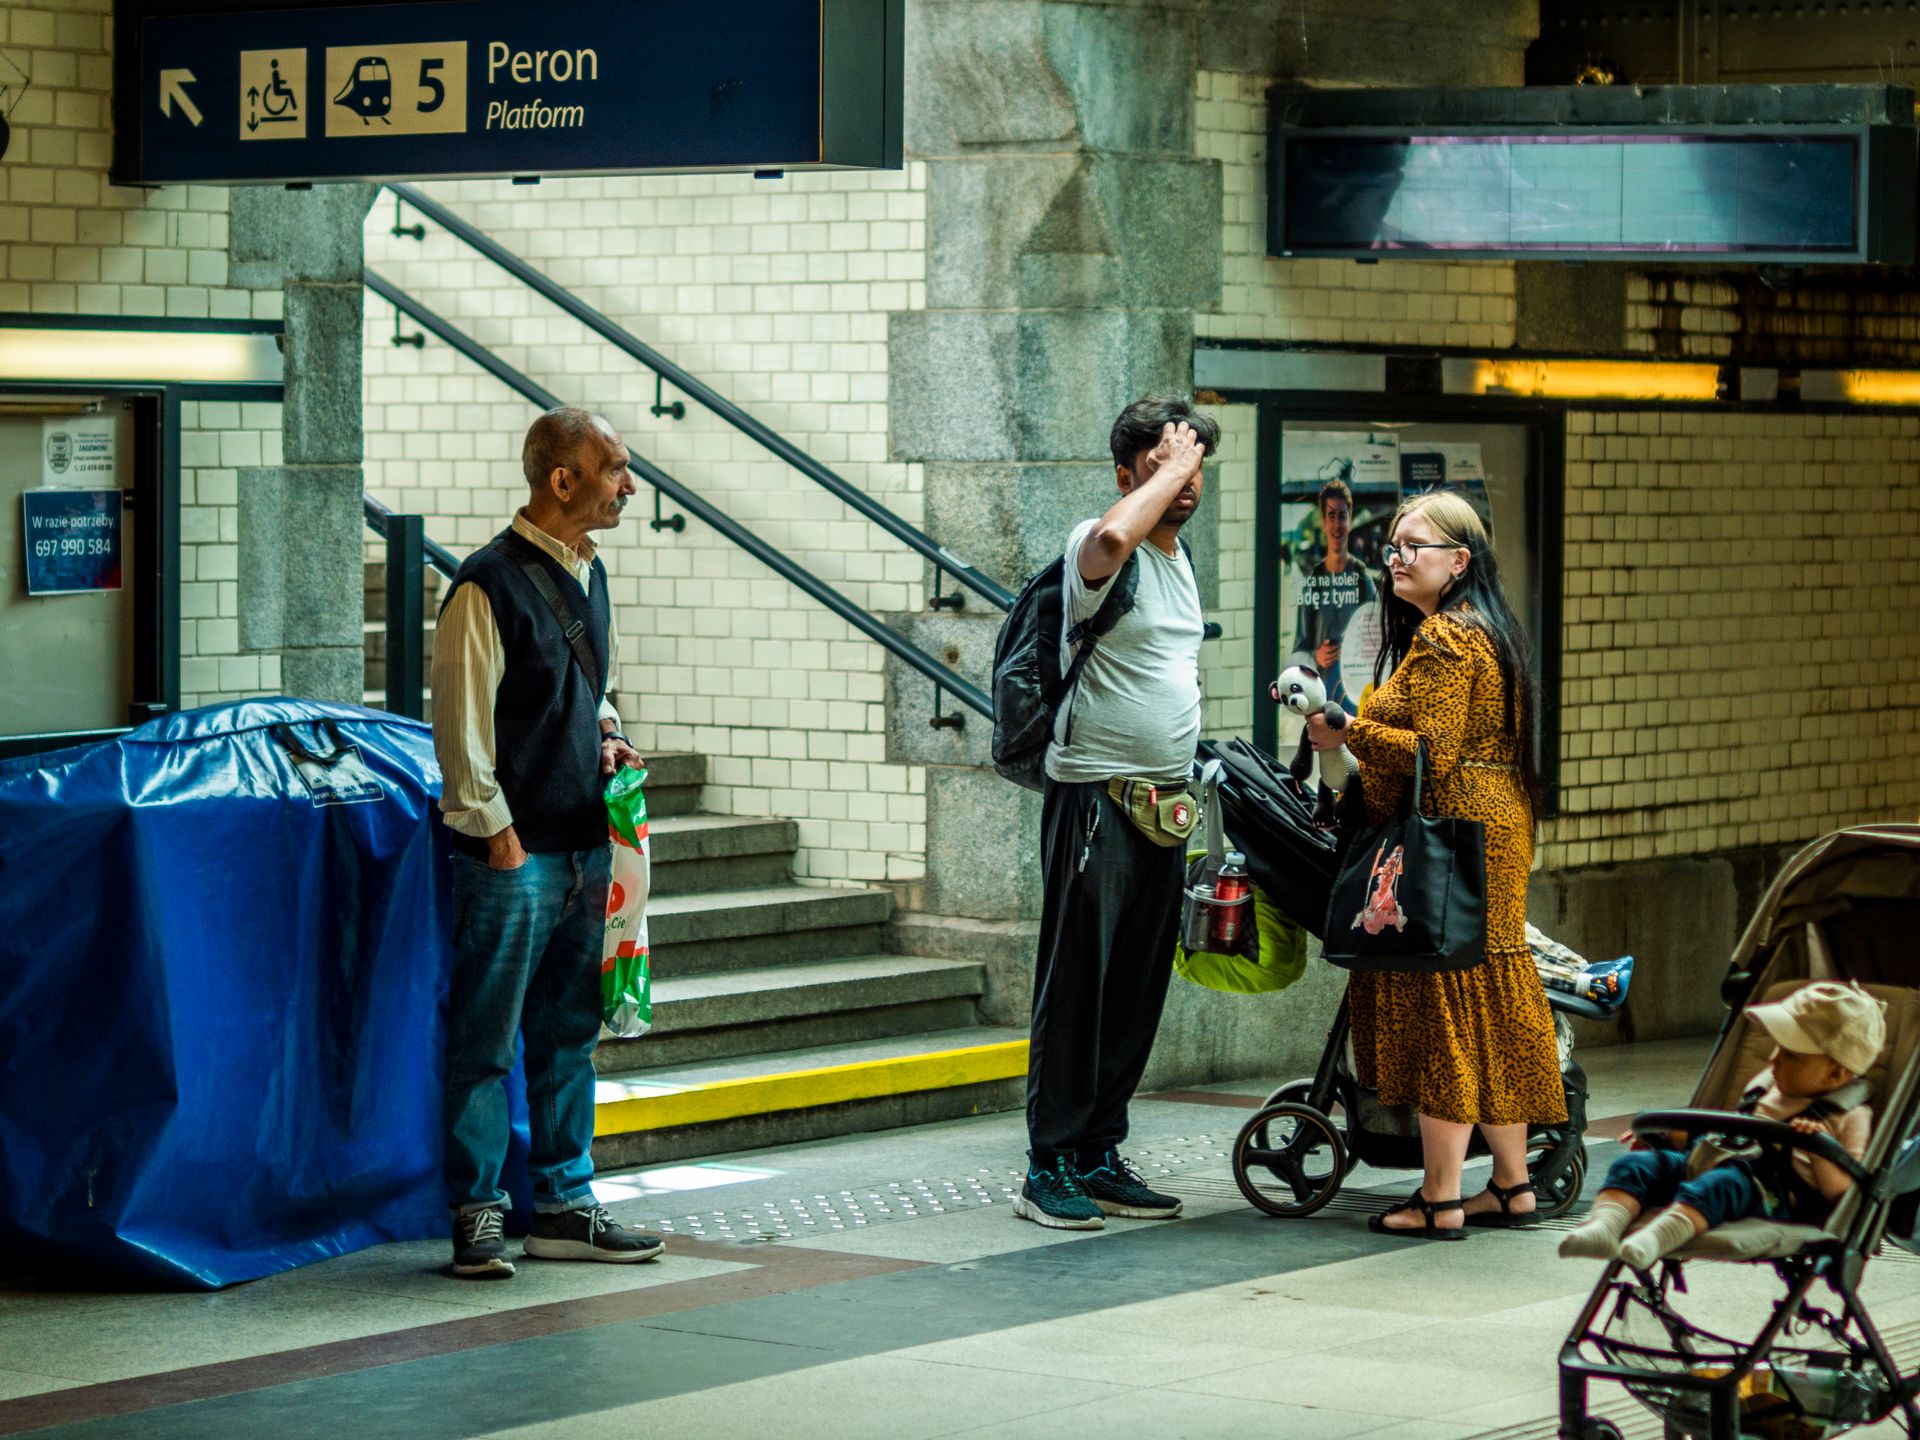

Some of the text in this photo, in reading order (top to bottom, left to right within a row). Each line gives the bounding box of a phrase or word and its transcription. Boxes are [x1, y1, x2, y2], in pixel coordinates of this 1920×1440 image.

[488, 41, 598, 84] Peron
[416, 57, 445, 113] 5
[485, 98, 585, 130] Platform
[32, 513, 114, 530] W razie potrzeby
[36, 538, 111, 556] 697 990 584
[1318, 576, 1330, 586] na
[1332, 572, 1360, 586] kolei?
[1322, 591, 1330, 604] z
[1332, 587, 1360, 608] tym!
